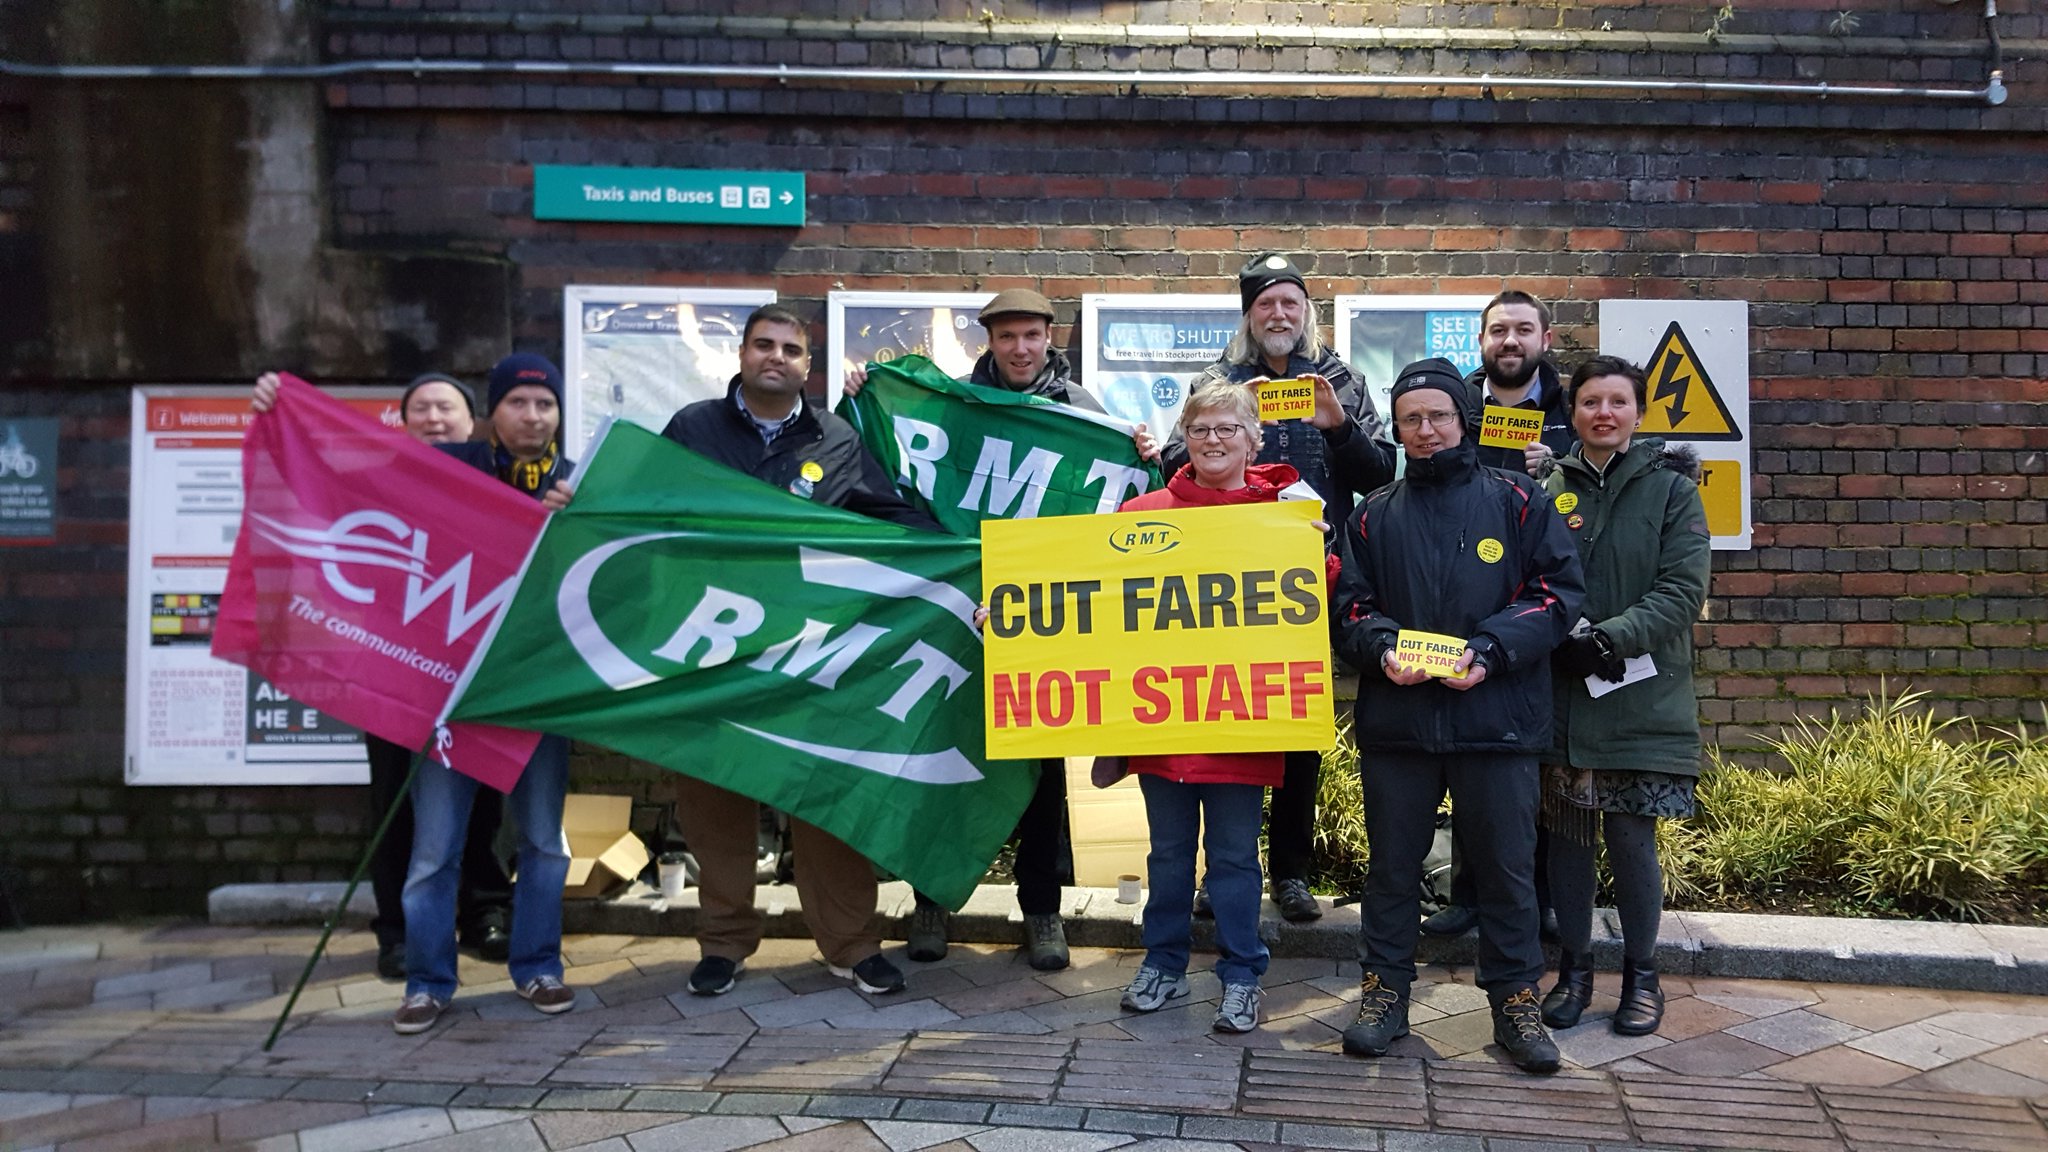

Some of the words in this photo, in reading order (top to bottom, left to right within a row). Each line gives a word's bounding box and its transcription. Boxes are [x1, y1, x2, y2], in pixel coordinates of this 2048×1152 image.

[583, 184, 625, 202] Taxis
[629, 186, 661, 203] and
[666, 187, 714, 204] Buses
[1431, 316, 1465, 333] SEE
[1112, 328, 1173, 344] MERO
[1176, 329, 1238, 344] SHUTT
[1431, 334, 1467, 350] SAY
[1116, 350, 1132, 358] free
[1133, 350, 1155, 358] travel
[1156, 351, 1164, 359] in
[1165, 351, 1202, 360] Stockport
[1158, 387, 1173, 399] 12
[1261, 389, 1279, 400] CUT
[1282, 387, 1311, 398] FARES
[1262, 402, 1280, 412] NOT
[1283, 400, 1312, 411] STAFF
[180, 412, 237, 426] Welcome
[1485, 414, 1505, 426] CUT
[1507, 417, 1540, 430] FARES
[1483, 427, 1504, 438] NOT
[1506, 430, 1538, 442] STAFF
[893, 414, 1150, 519] RMT
[1125, 530, 1170, 546] RMT
[288, 594, 326, 625] The
[990, 580, 1101, 638] CUT
[1122, 567, 1321, 633] FARES
[651, 585, 972, 723] RMT
[1400, 639, 1423, 650] CUT
[1426, 642, 1463, 657] FARES
[1398, 651, 1423, 662] NOT
[1425, 655, 1458, 667] STAF
[993, 668, 1111, 729] NOT
[1132, 660, 1325, 724] STAFF
